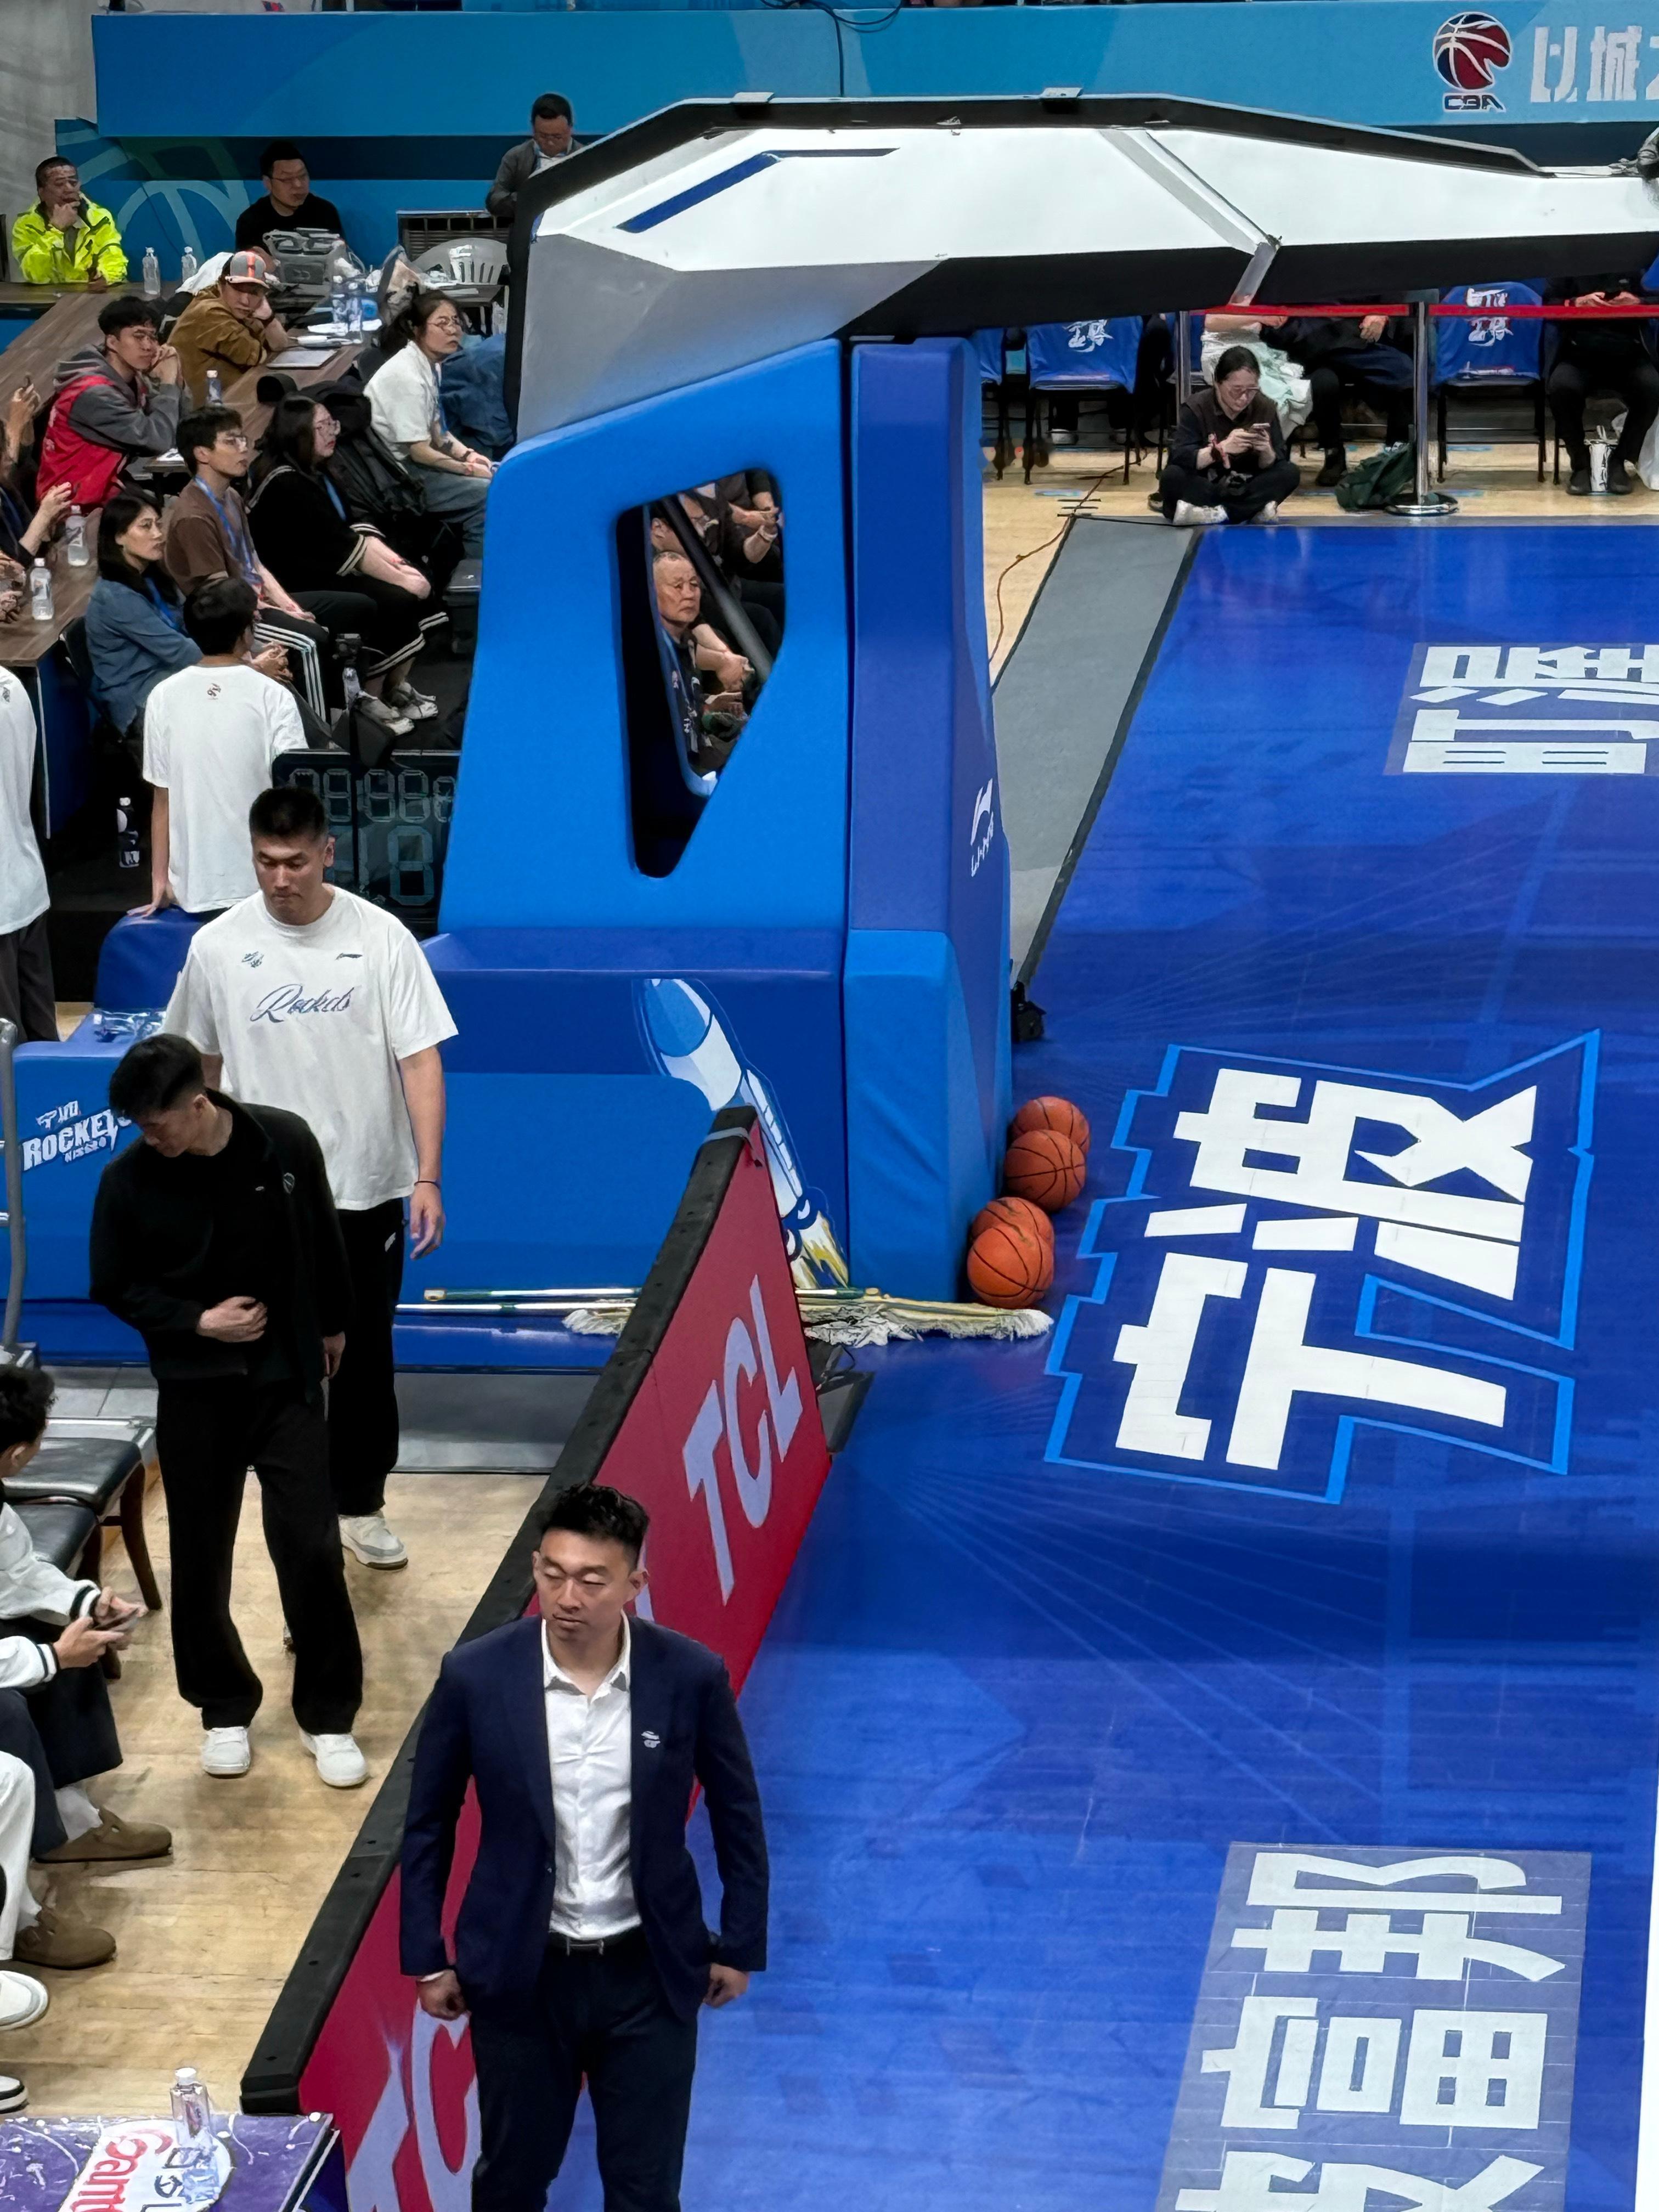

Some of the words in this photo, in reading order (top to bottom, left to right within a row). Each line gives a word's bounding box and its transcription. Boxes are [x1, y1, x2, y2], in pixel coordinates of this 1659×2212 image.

[1444, 94, 1504, 111] CBA
[1530, 26, 1659, 103] 以城
[1114, 1068, 1537, 1471] 宁波
[682, 1274, 803, 1607] TCL
